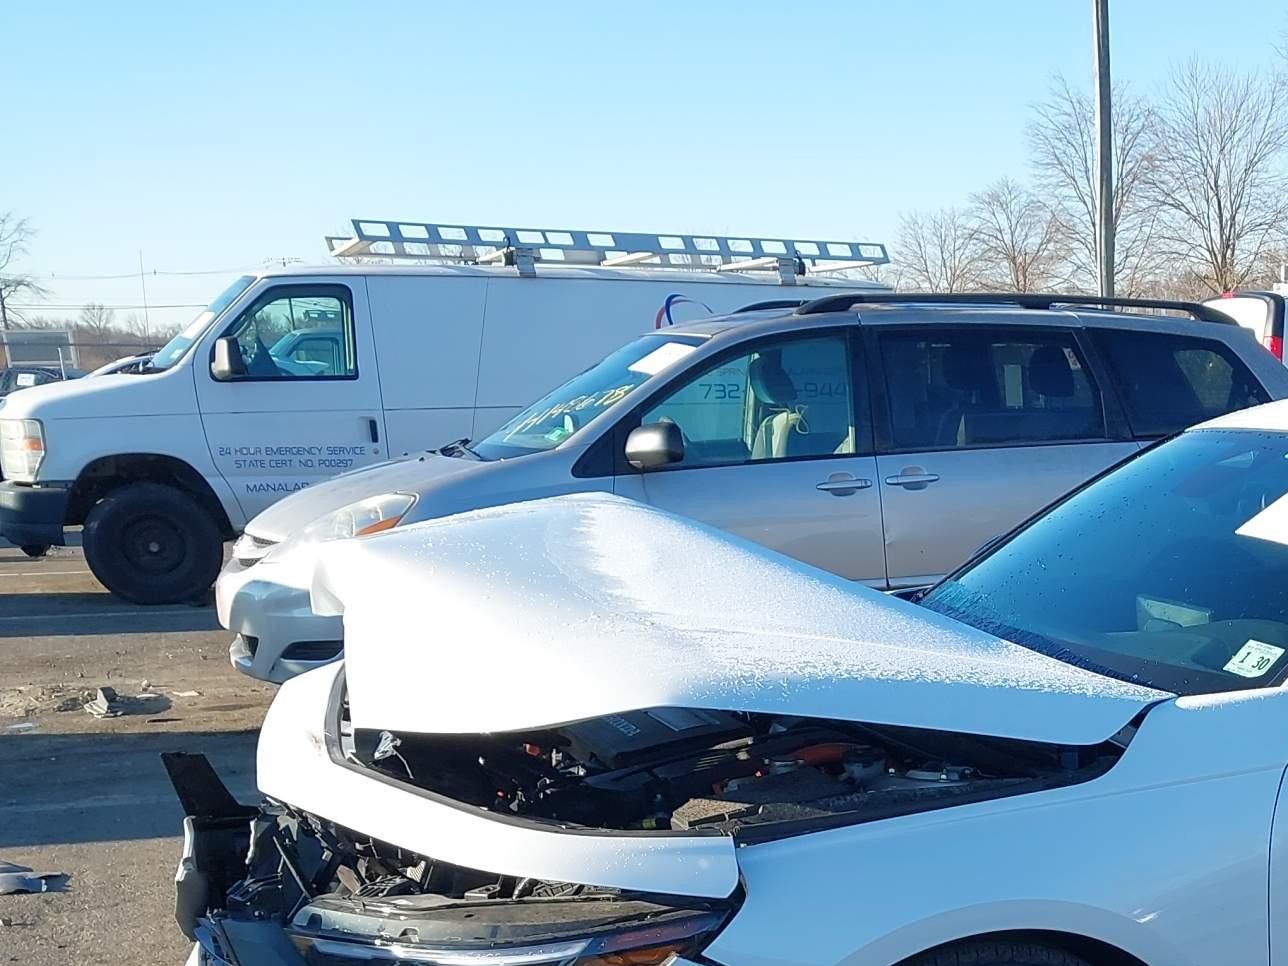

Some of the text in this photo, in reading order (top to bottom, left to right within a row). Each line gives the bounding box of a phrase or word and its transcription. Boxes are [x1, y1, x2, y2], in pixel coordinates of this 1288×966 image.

[219, 447, 366, 456] 24 HOUR EMERGENCY SERVICE
[235, 459, 266, 469] STATE
[1251, 656, 1271, 671] 30
